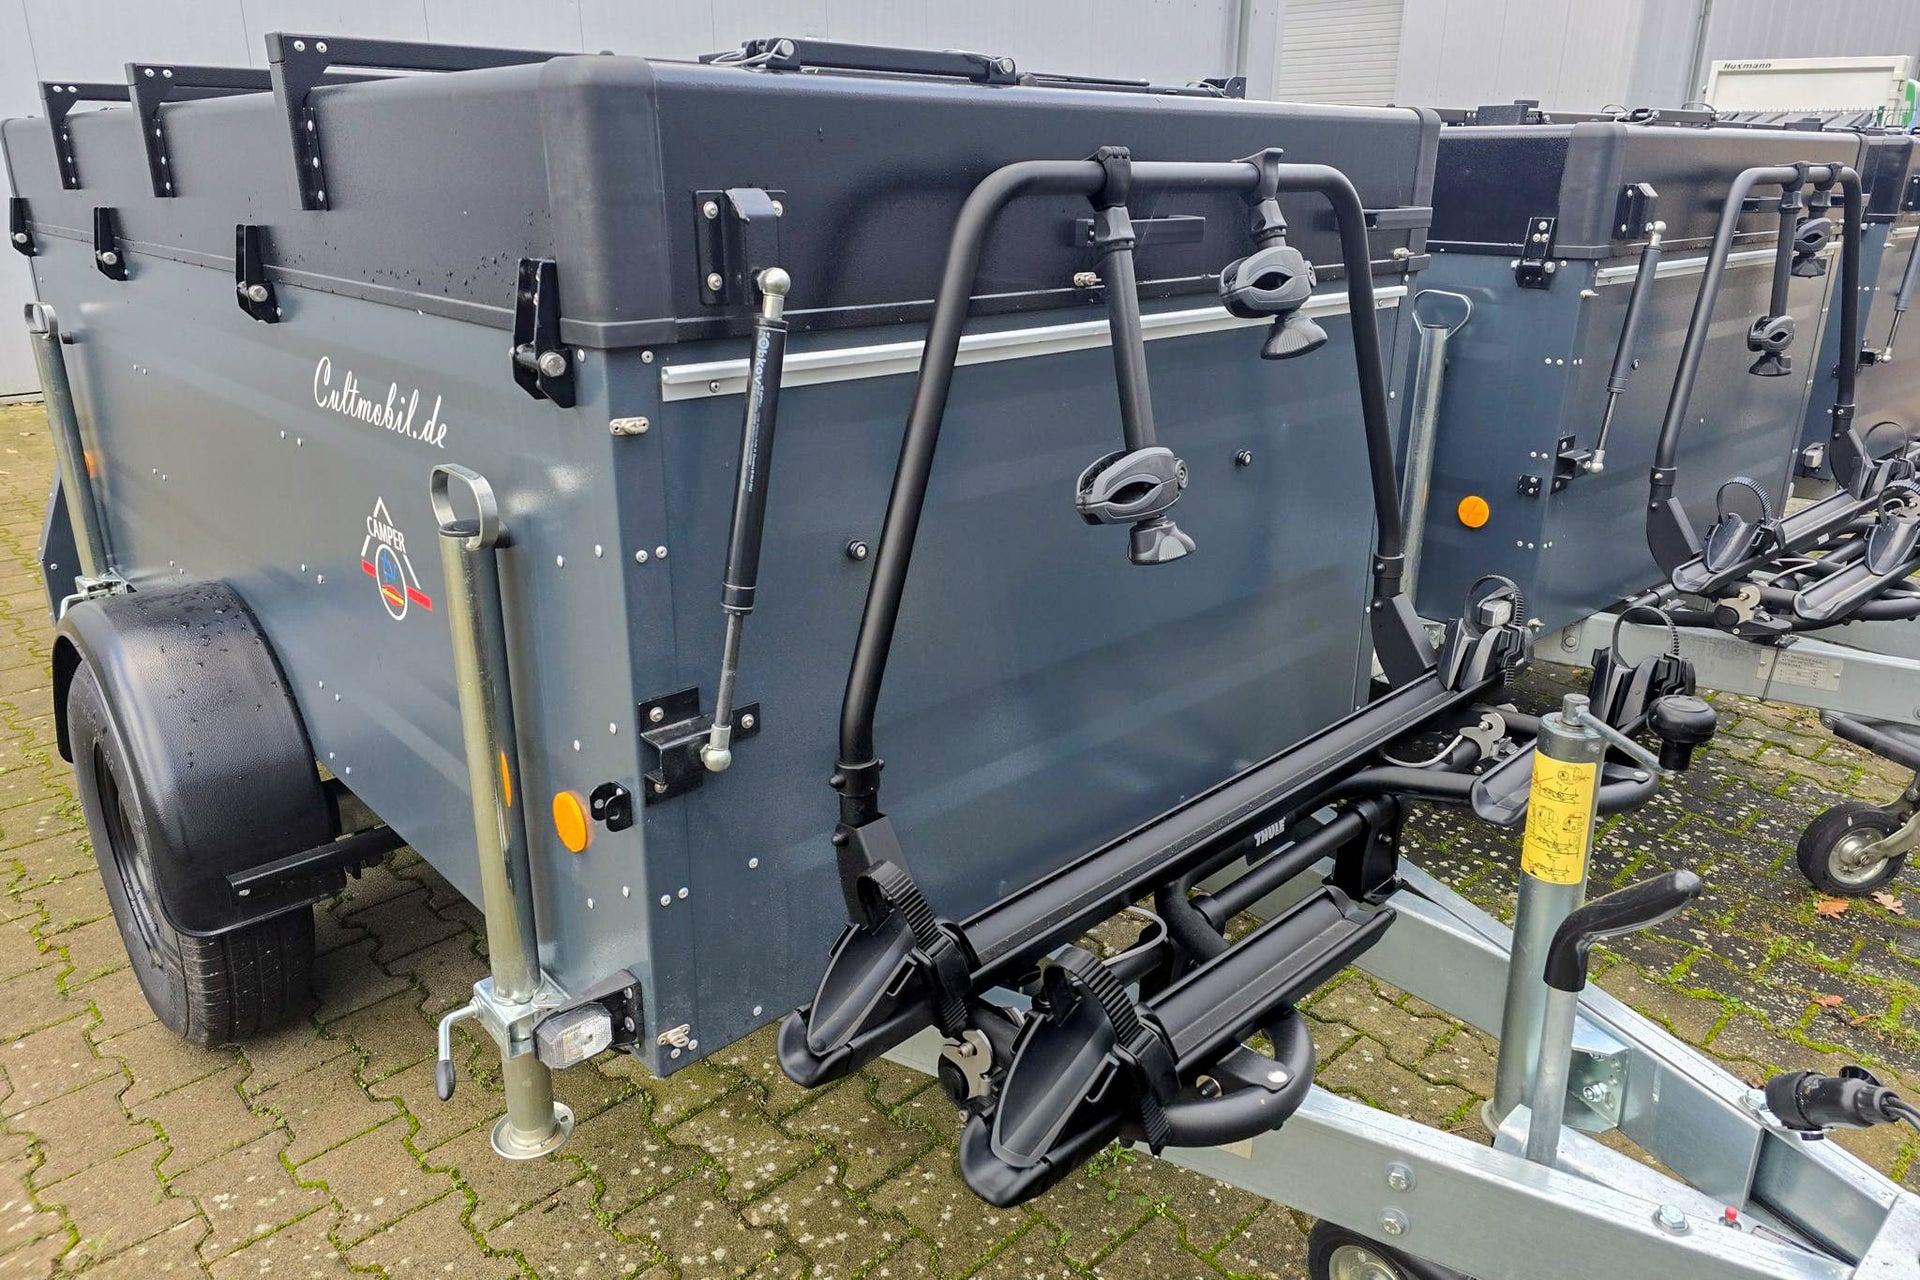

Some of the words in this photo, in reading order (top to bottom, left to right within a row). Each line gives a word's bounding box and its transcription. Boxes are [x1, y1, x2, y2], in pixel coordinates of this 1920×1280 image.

[314, 356, 447, 448] Cultmobil.de
[367, 516, 406, 554] CAMPER
[1254, 817, 1285, 847] THULE
